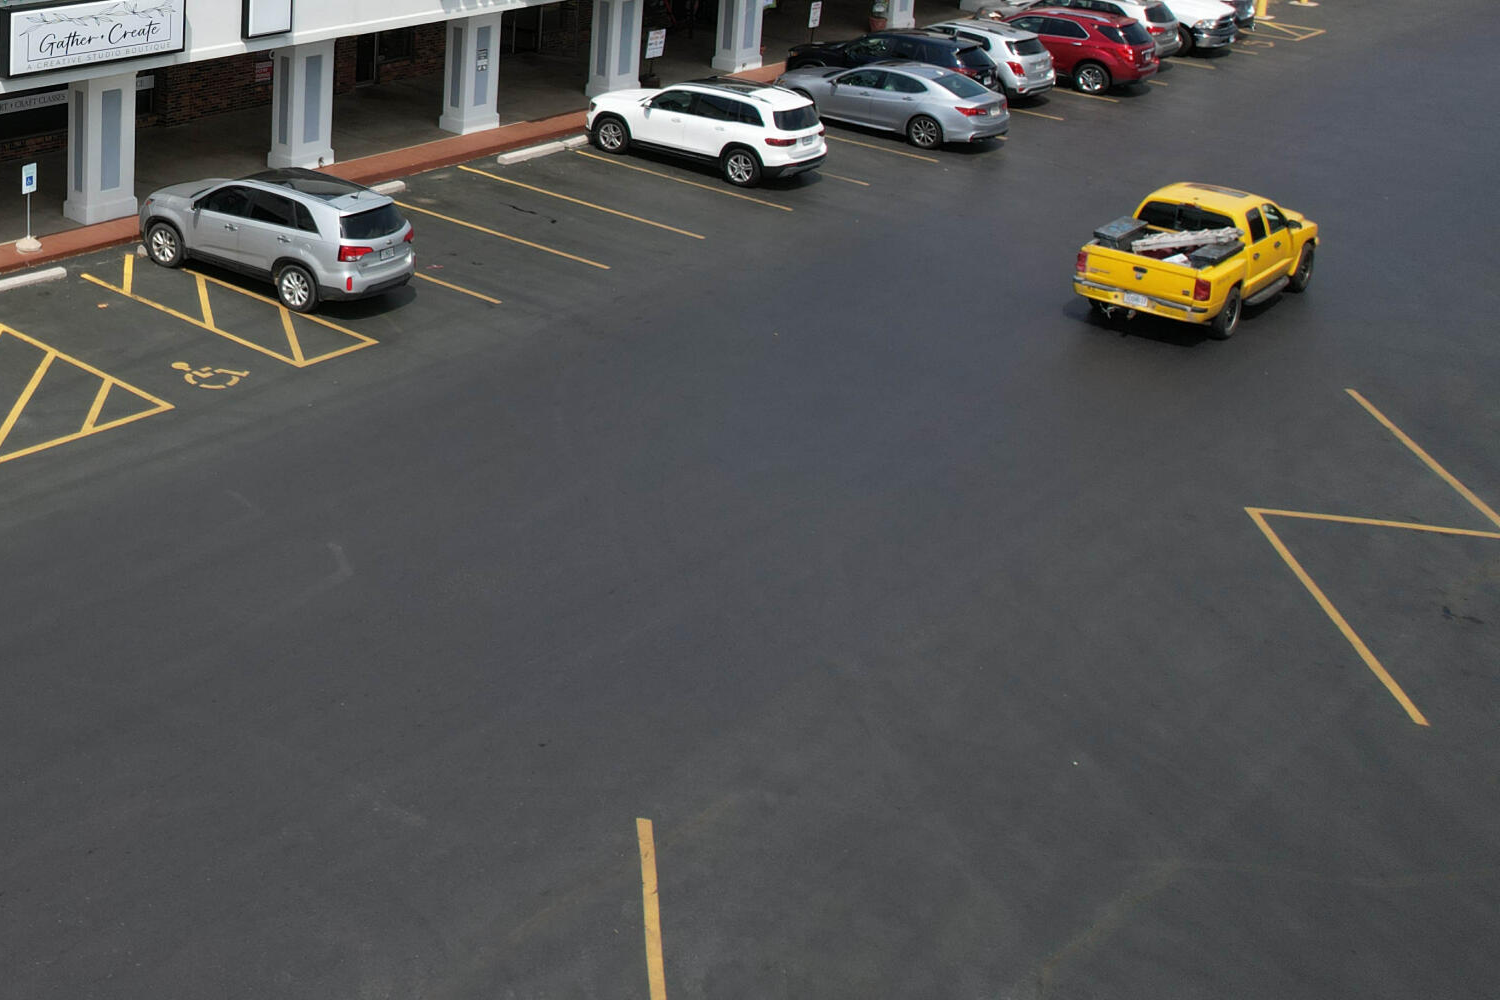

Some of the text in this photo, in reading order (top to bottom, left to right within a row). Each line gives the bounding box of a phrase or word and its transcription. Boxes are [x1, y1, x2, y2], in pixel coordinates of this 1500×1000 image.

[39, 20, 161, 56] Gather Create
[36, 55, 82, 68] CREATIVE
[86, 49, 121, 60] STUDIO
[125, 41, 171, 55] BOUTIQUE
